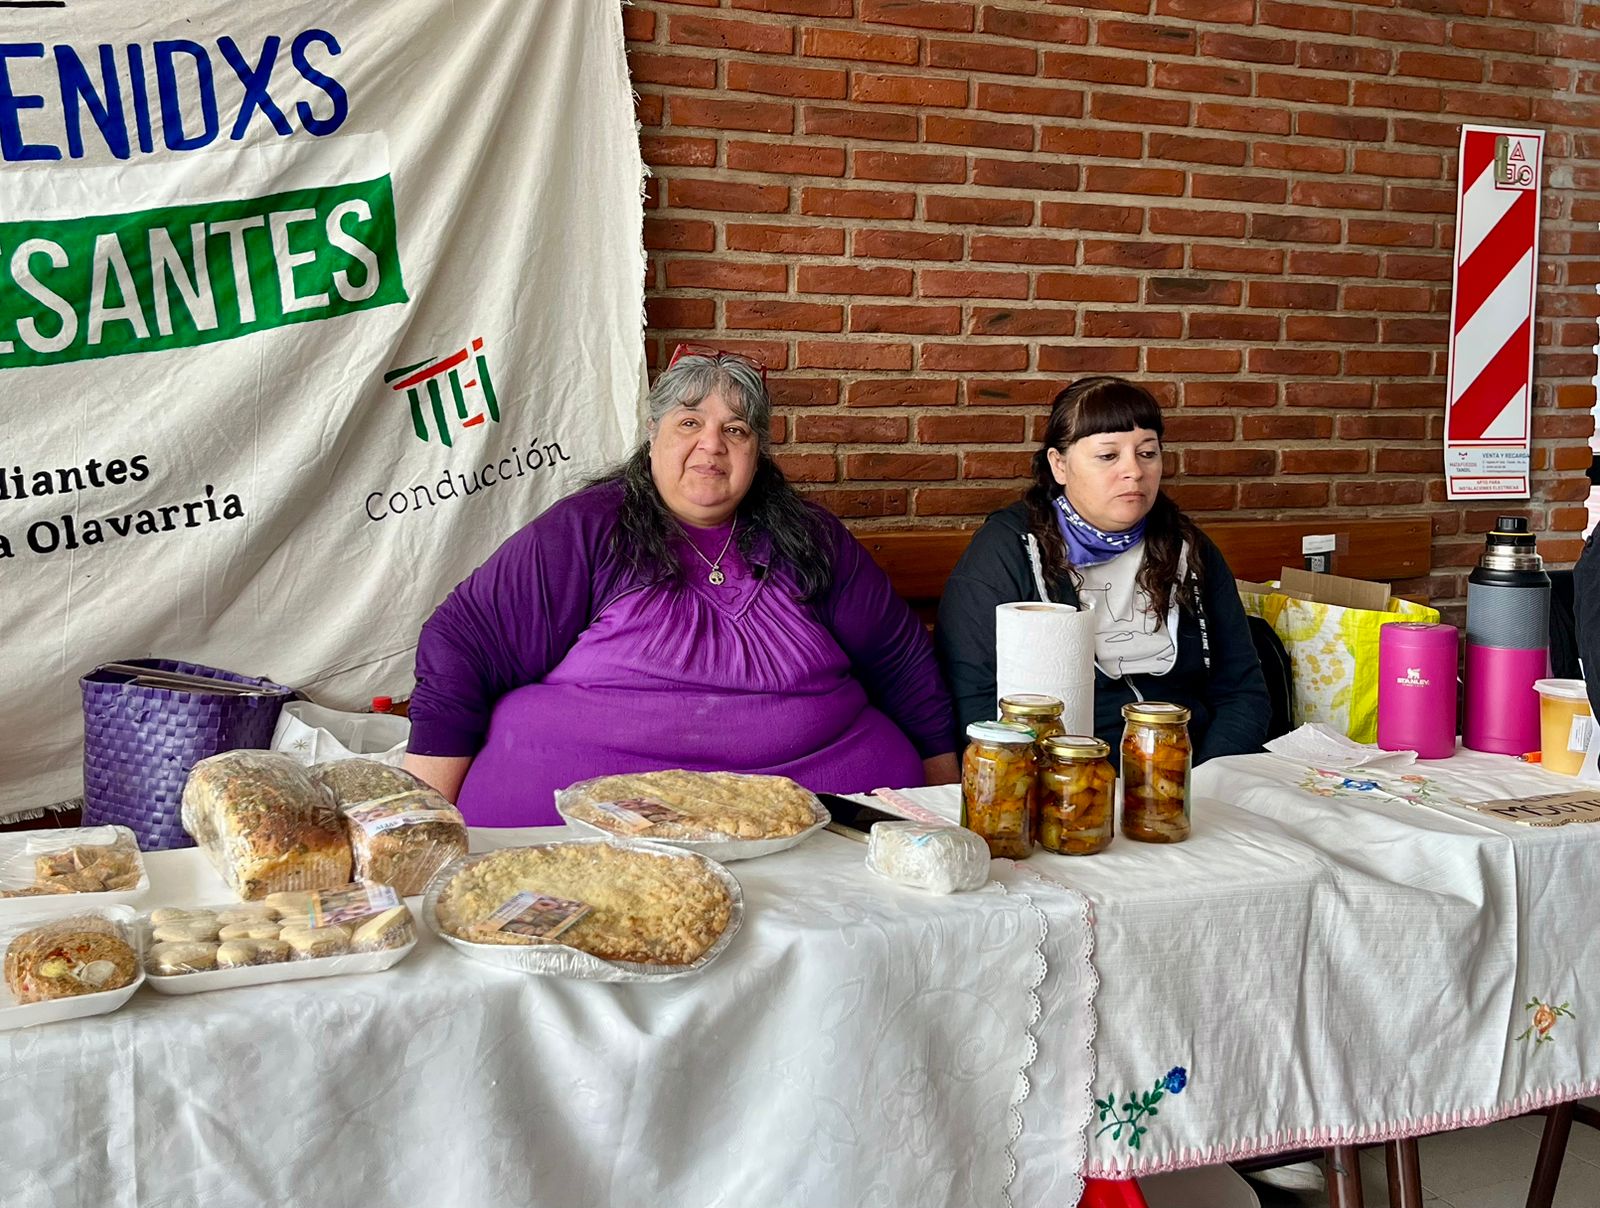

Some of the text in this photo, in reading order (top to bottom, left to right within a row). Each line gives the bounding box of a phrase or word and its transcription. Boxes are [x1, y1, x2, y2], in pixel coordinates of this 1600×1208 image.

[0, 199, 382, 354] SANTES
[26, 484, 245, 554] Olavarría
[365, 437, 571, 521] Conducción
